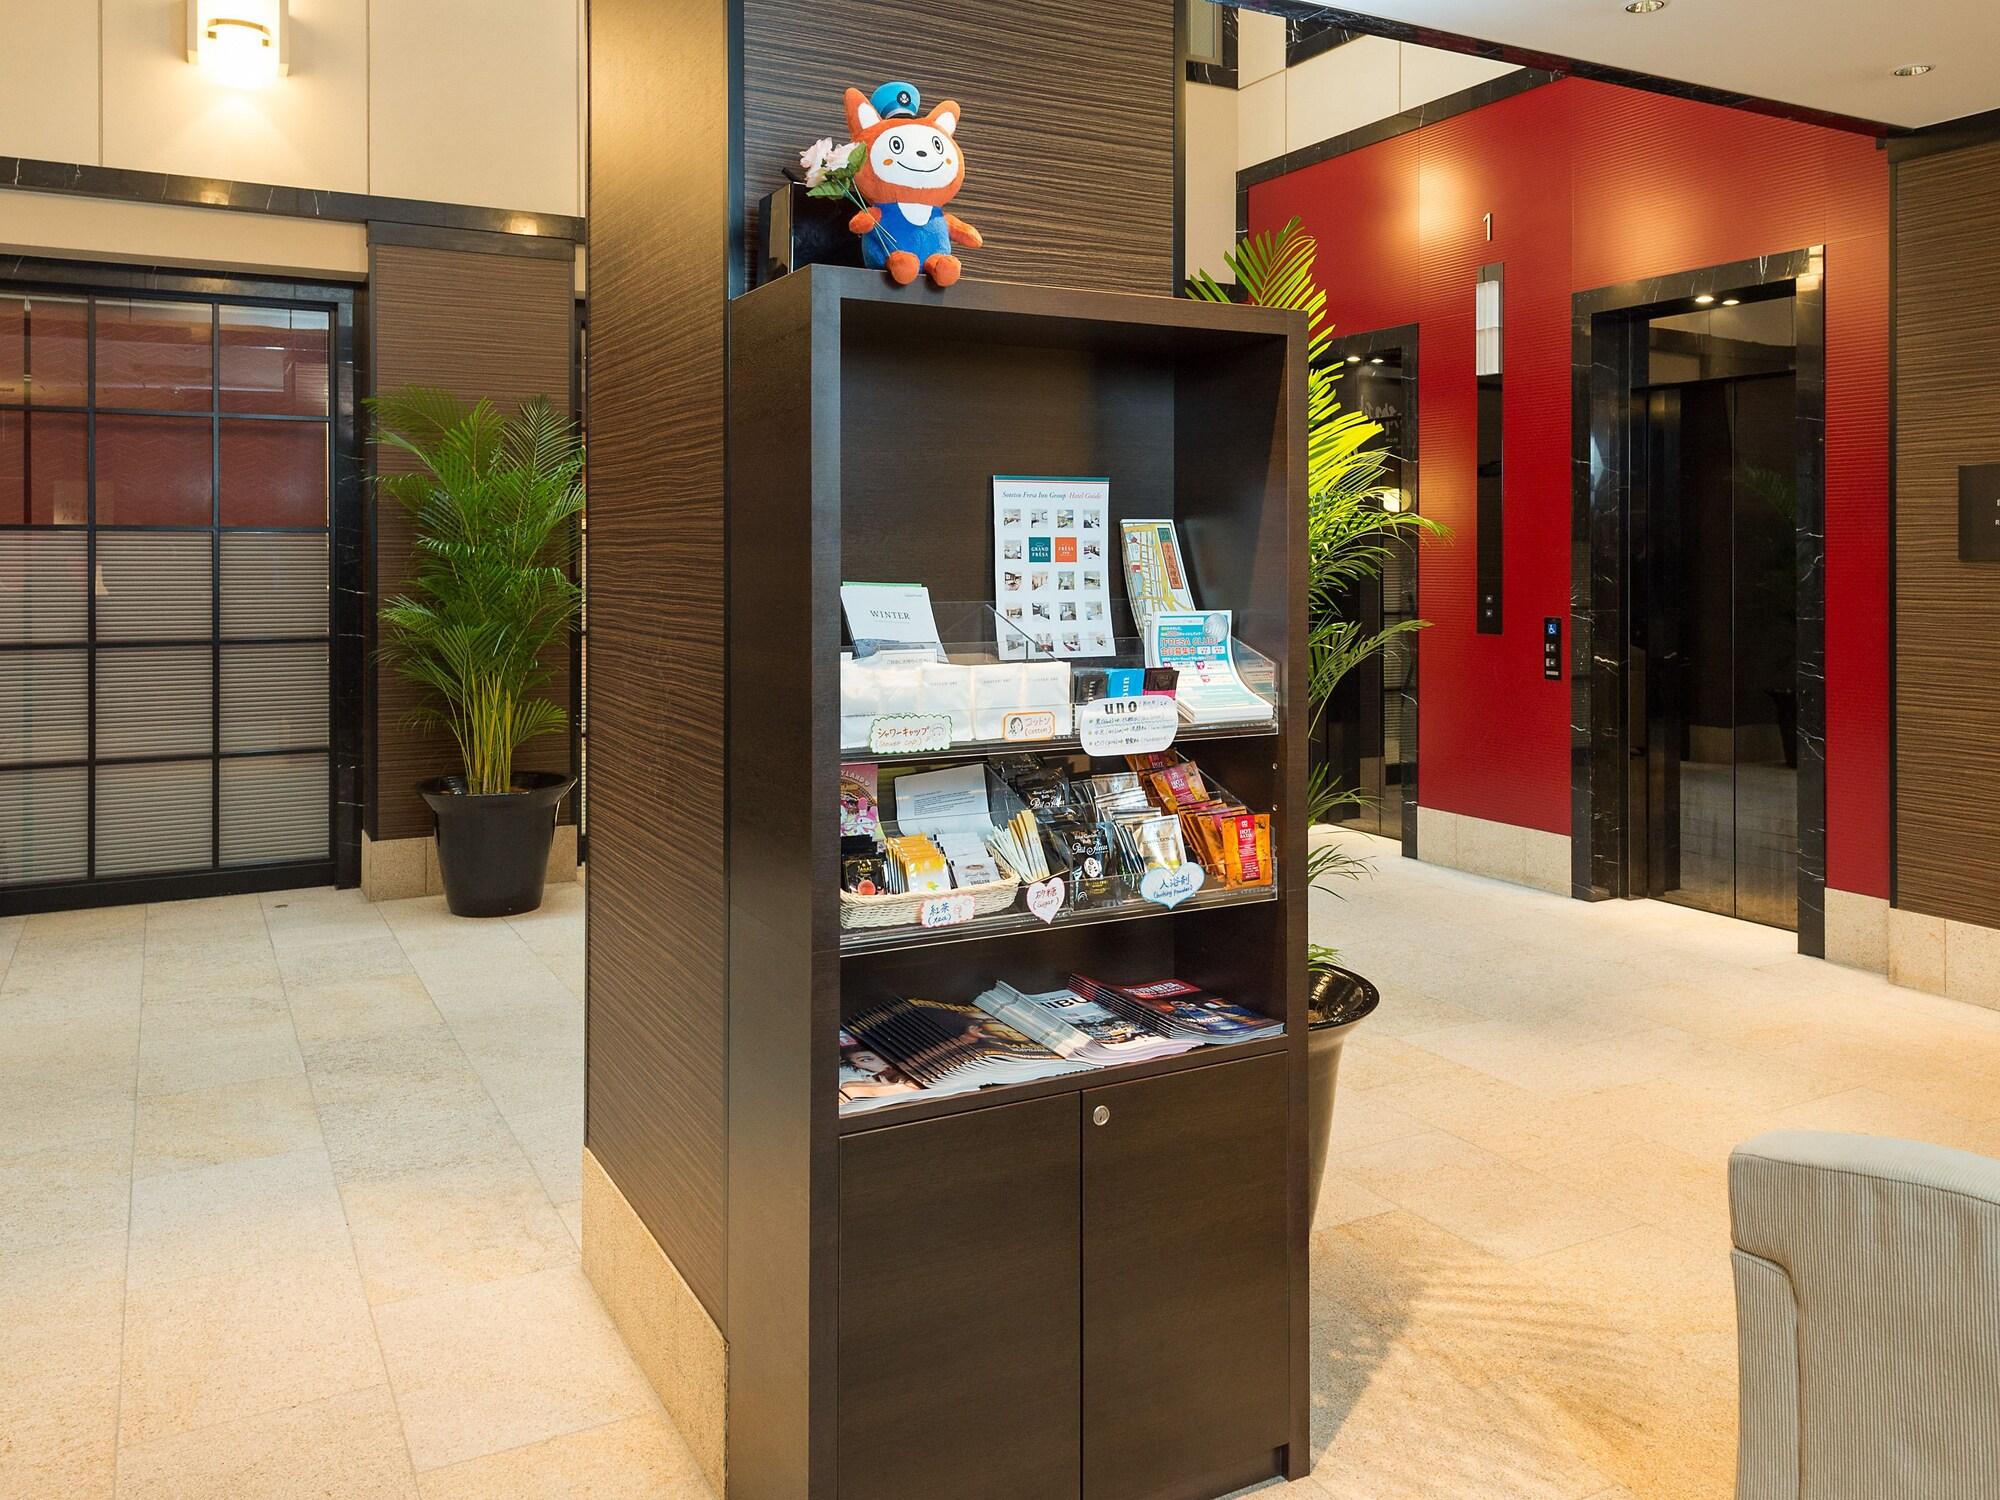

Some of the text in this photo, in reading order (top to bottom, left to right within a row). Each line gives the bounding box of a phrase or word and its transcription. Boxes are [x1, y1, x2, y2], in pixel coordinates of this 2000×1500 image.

[1482, 212, 1491, 241] 1
[870, 610, 910, 620] WINTER
[1104, 701, 1138, 715] uno
[1024, 717, 1051, 727] コットン
[878, 726, 930, 739] シャワーキャップ
[841, 769, 865, 783] YLAND
[1171, 778, 1184, 786] HOT
[1160, 874, 1190, 889] 入浴剤
[1035, 887, 1057, 899] 砂糖
[930, 902, 950, 916] 紅茶
